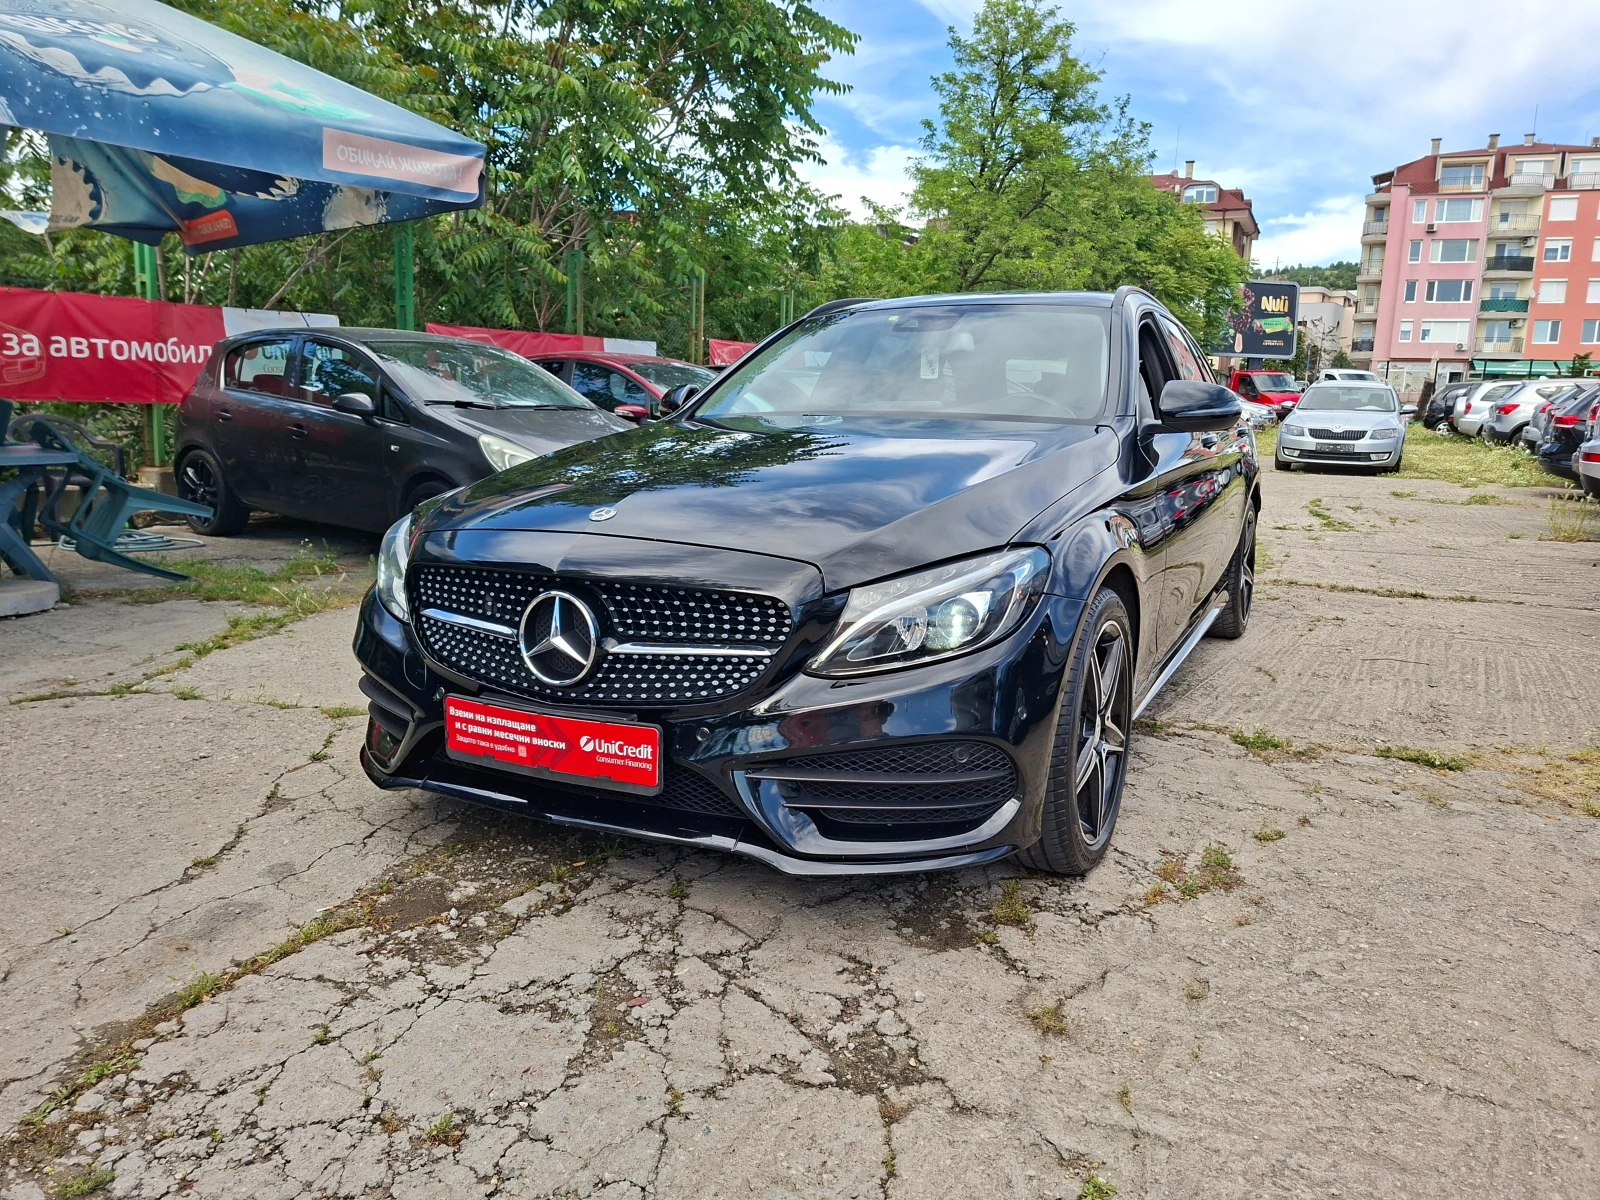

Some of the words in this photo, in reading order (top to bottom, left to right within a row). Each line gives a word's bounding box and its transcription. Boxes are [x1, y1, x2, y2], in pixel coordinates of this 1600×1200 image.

[1261, 295, 1289, 312] Nuii
[2, 333, 40, 356] за
[449, 706, 474, 720] Вземи
[475, 713, 485, 722] на
[486, 716, 536, 732] изплащане
[456, 734, 477, 744] Защото
[477, 740, 489, 748] така
[494, 744, 516, 753] удобно
[468, 724, 492, 737] равни
[494, 729, 531, 744] месечни
[532, 737, 566, 750] вноски
[595, 738, 653, 759] UniCredit
[596, 755, 624, 765] Consumer
[625, 759, 653, 771] Financing
